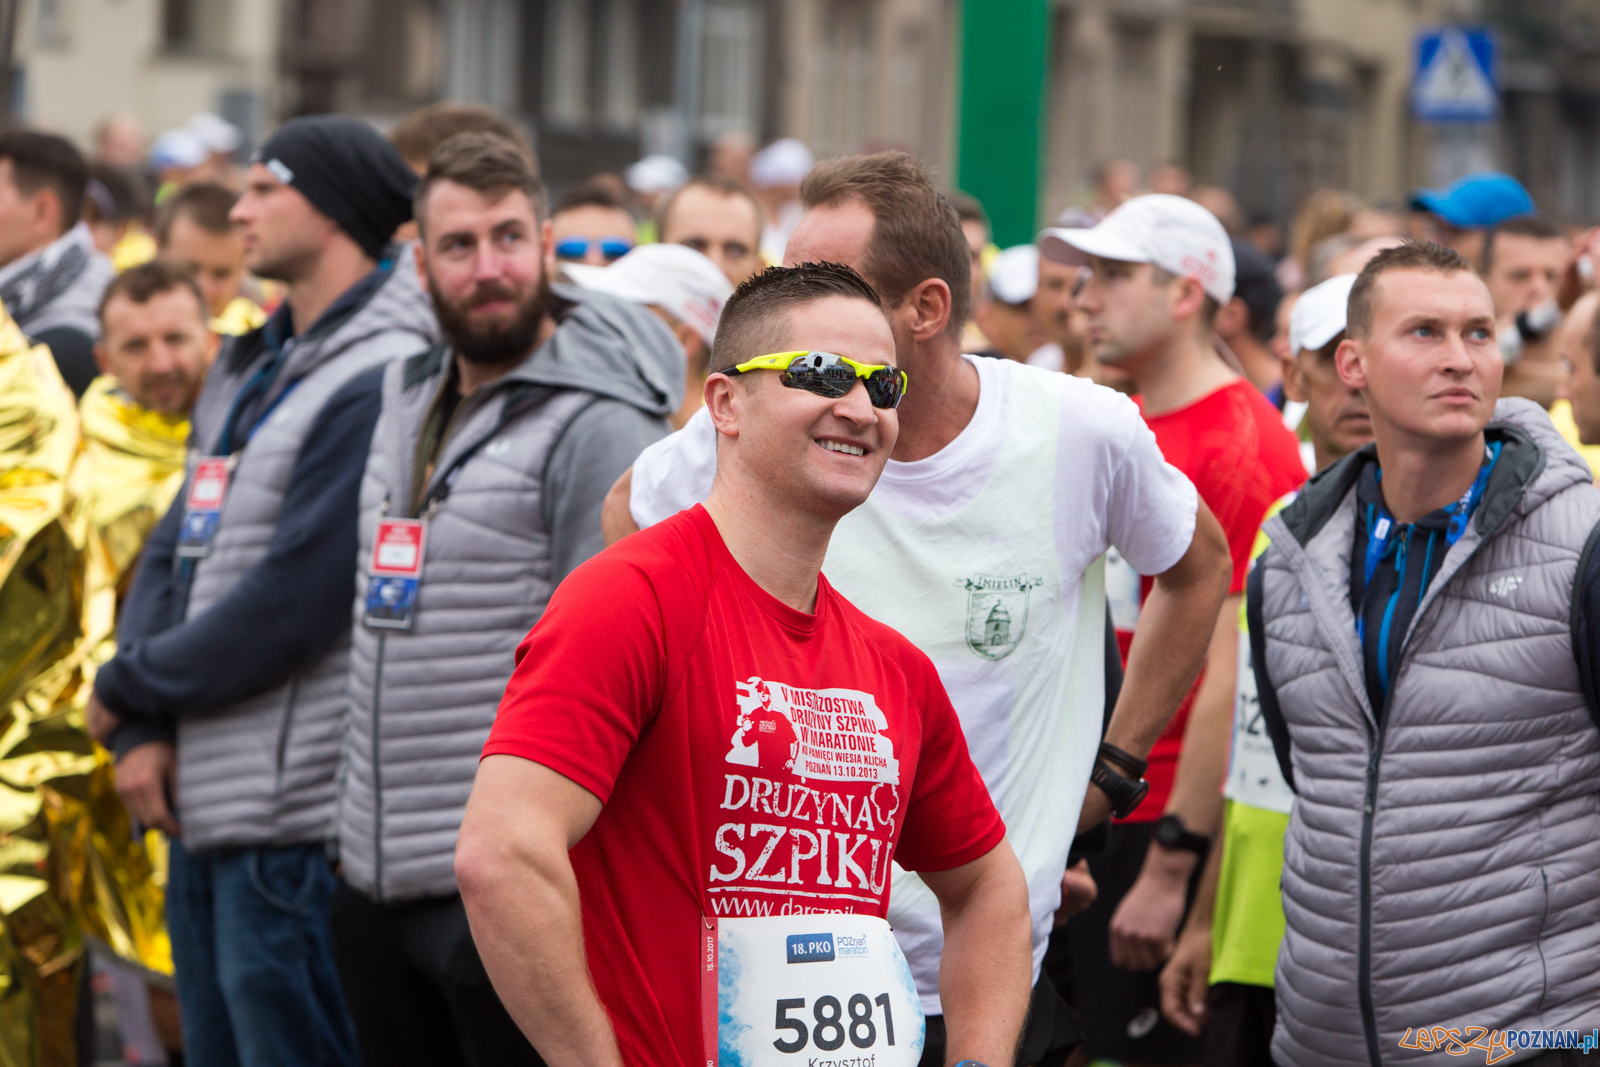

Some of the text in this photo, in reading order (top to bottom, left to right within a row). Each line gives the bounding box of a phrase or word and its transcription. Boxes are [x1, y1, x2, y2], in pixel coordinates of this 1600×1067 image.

[978, 576, 1021, 590] IMIELIN
[781, 686, 788, 703] V
[836, 716, 877, 735] SZPIKU
[800, 726, 877, 753] W MARATONIE
[809, 748, 834, 762] PAMIĘCI
[835, 753, 862, 764] WIESIA
[864, 755, 887, 768] KLICHA
[805, 760, 878, 779] POZNAŃ 13.10.2013
[720, 774, 875, 831] DRUŻYNA
[709, 823, 892, 895] SZPIKU
[808, 941, 831, 954] PKO
[838, 946, 869, 955] maraton
[773, 993, 896, 1054] 5881
